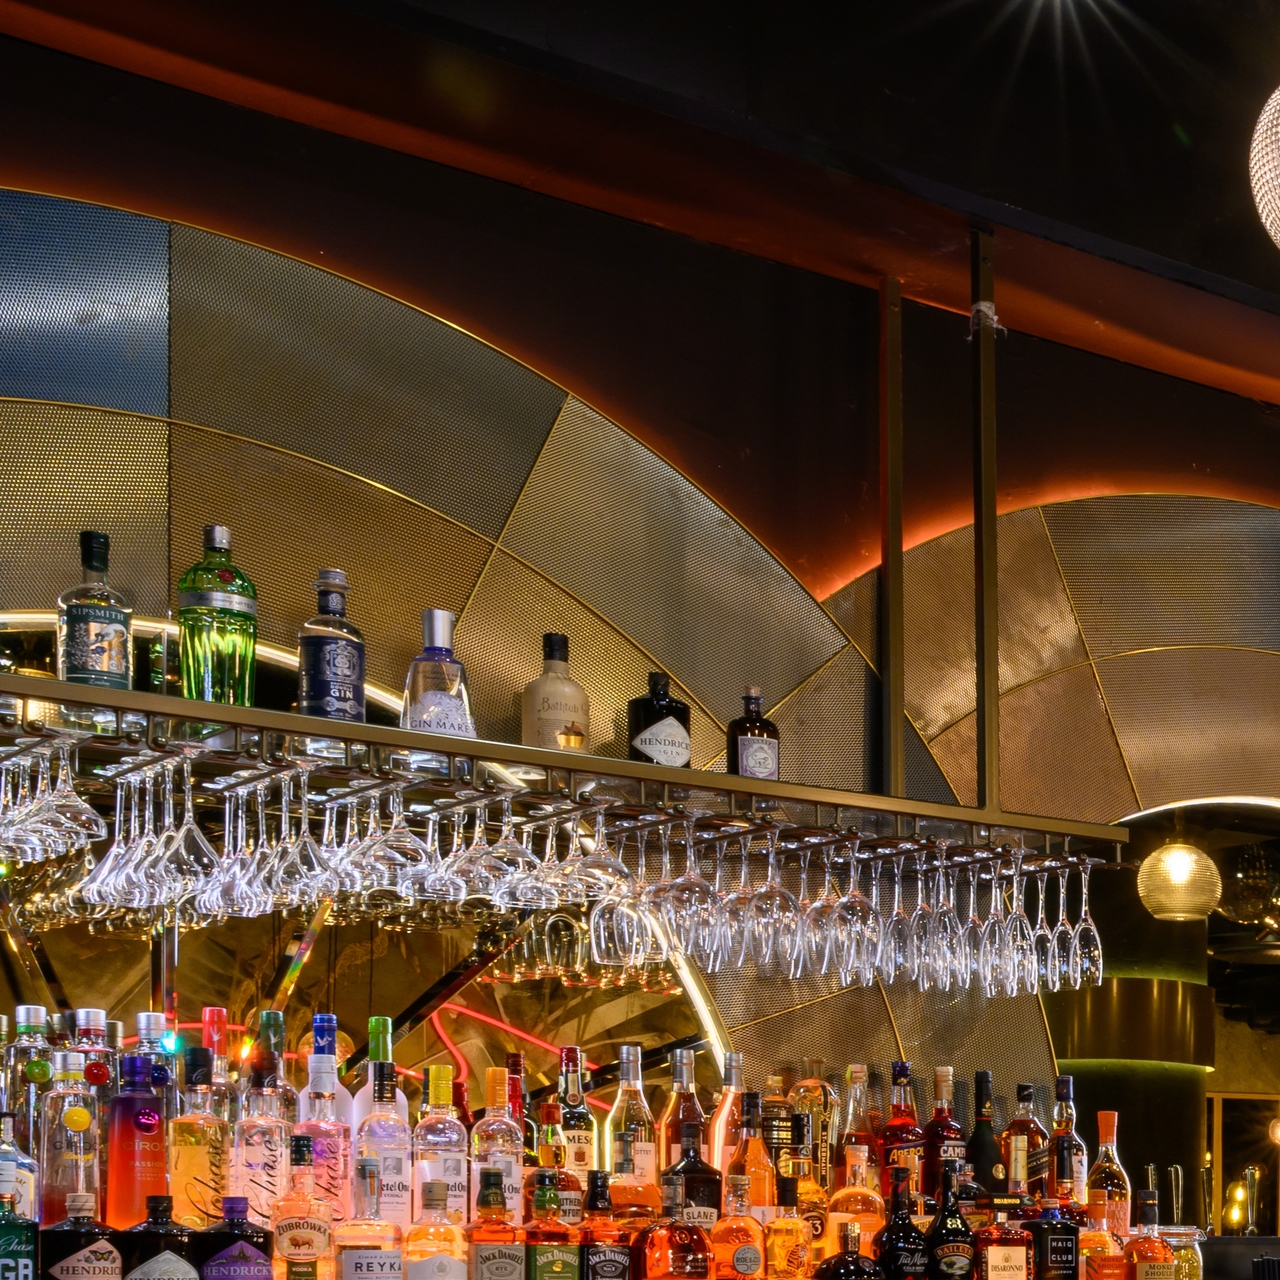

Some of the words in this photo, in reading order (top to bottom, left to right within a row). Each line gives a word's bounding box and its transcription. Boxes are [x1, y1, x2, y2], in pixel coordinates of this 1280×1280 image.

[71, 607, 125, 621] SIPSMITH
[330, 688, 354, 700] GIN
[541, 696, 579, 713] Bathtub
[410, 720, 432, 729] GIN
[436, 721, 470, 734] MARE
[1107, 1202, 1128, 1210] GLEN
[686, 1211, 715, 1220] SLANE
[936, 1246, 972, 1256] BAILEYS
[480, 1252, 498, 1265] JACK
[498, 1250, 524, 1266] DANIEL'S
[536, 1252, 554, 1266] JACK
[554, 1250, 579, 1266] DANIEL'S
[588, 1252, 606, 1266] JACK
[606, 1250, 630, 1266] DANIEL'S
[1052, 1254, 1072, 1262] CLUB
[990, 1264, 1024, 1272] DISARONNO
